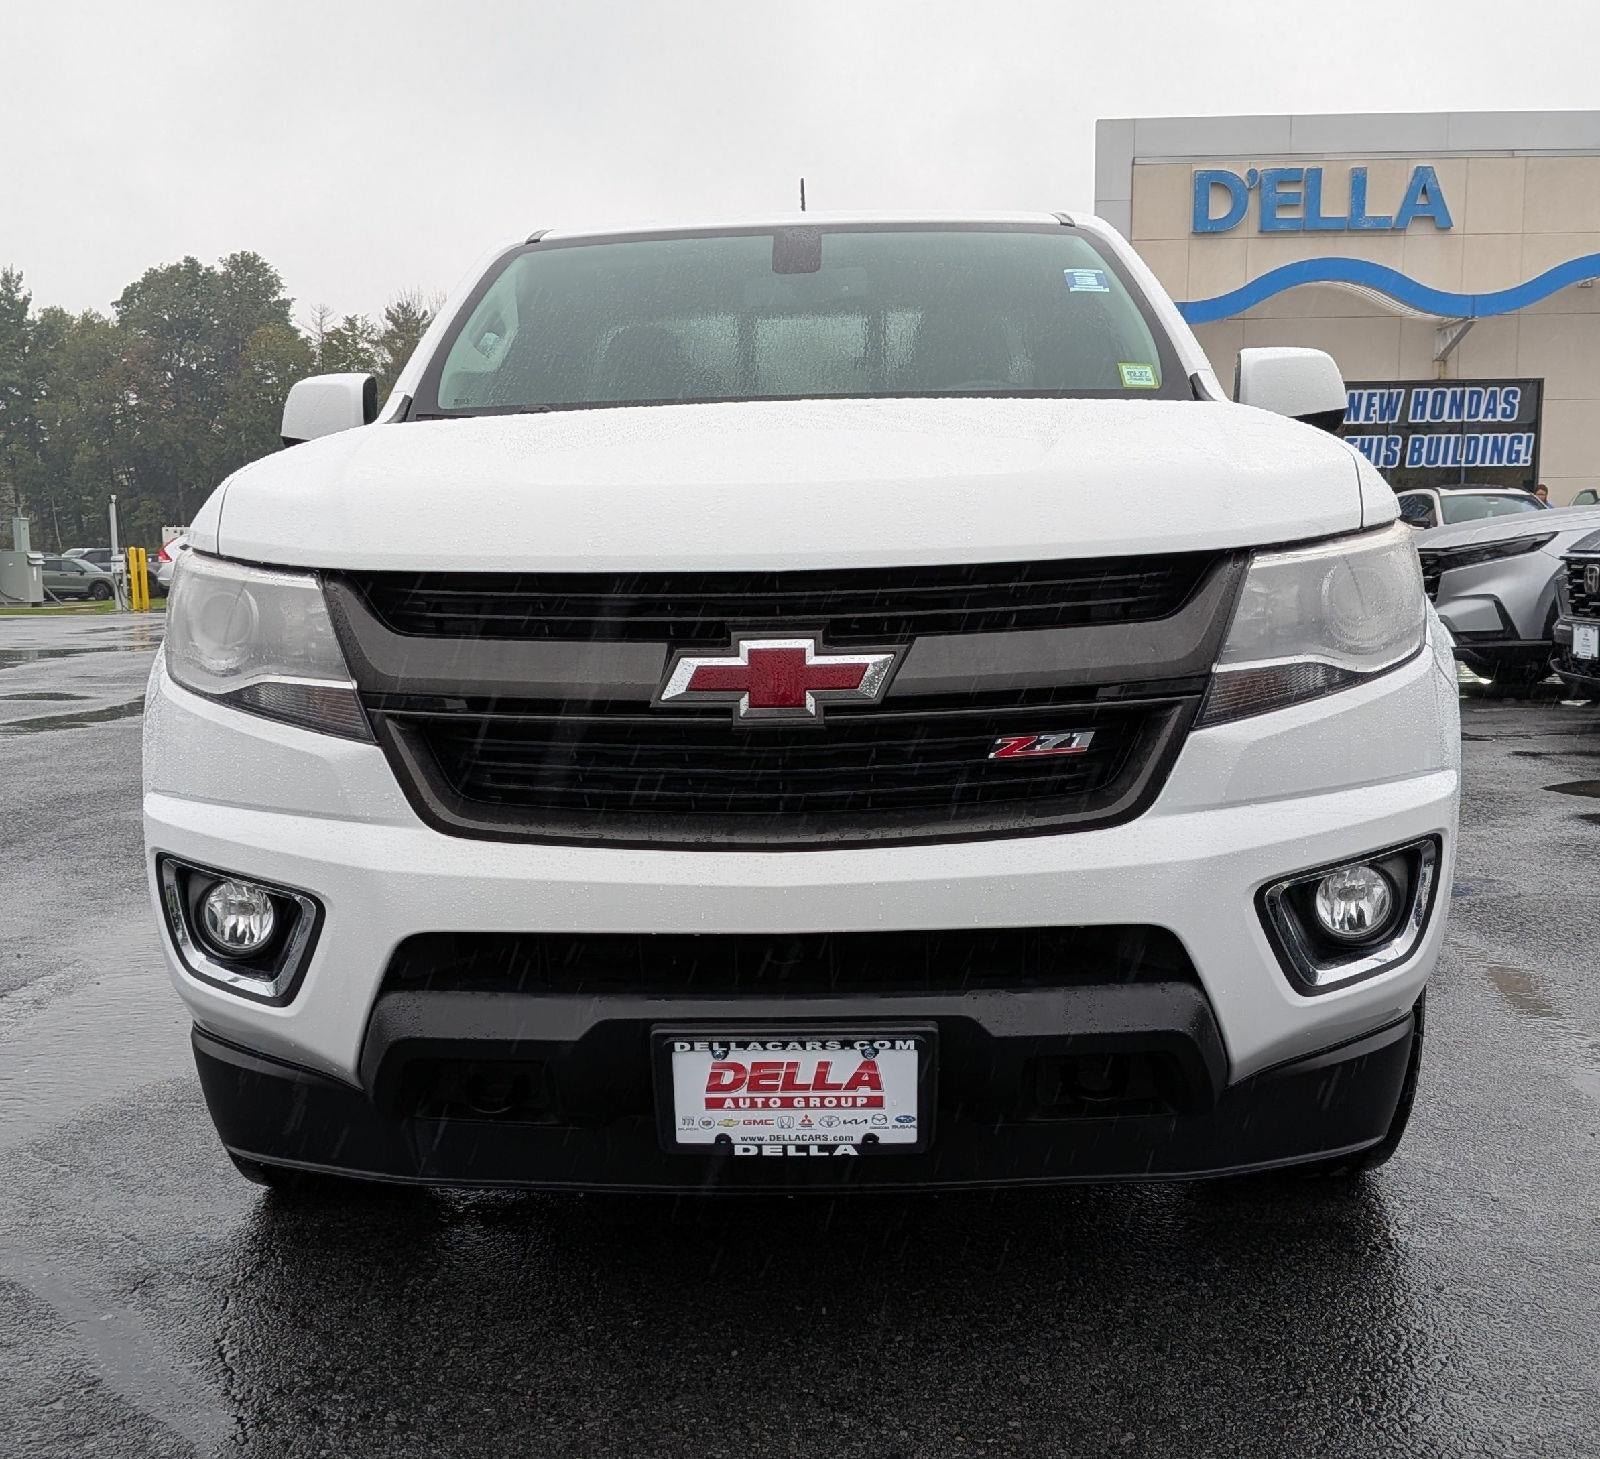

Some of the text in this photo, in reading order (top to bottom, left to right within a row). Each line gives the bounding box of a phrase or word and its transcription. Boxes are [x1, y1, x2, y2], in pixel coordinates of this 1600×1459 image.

[1192, 166, 1454, 234] D'ELLA
[1343, 387, 1521, 424] NEW HONDAS
[1405, 433, 1535, 468] BUILDING!
[988, 731, 1095, 759] Z71
[674, 1040, 915, 1052] DELLACARS.COM
[705, 1060, 884, 1094] DELLA
[723, 1097, 868, 1109] AUTO GROUP
[742, 1118, 775, 1126] GMC
[740, 1134, 854, 1142] www.DELLACARS.com
[734, 1144, 859, 1156] DELLA
